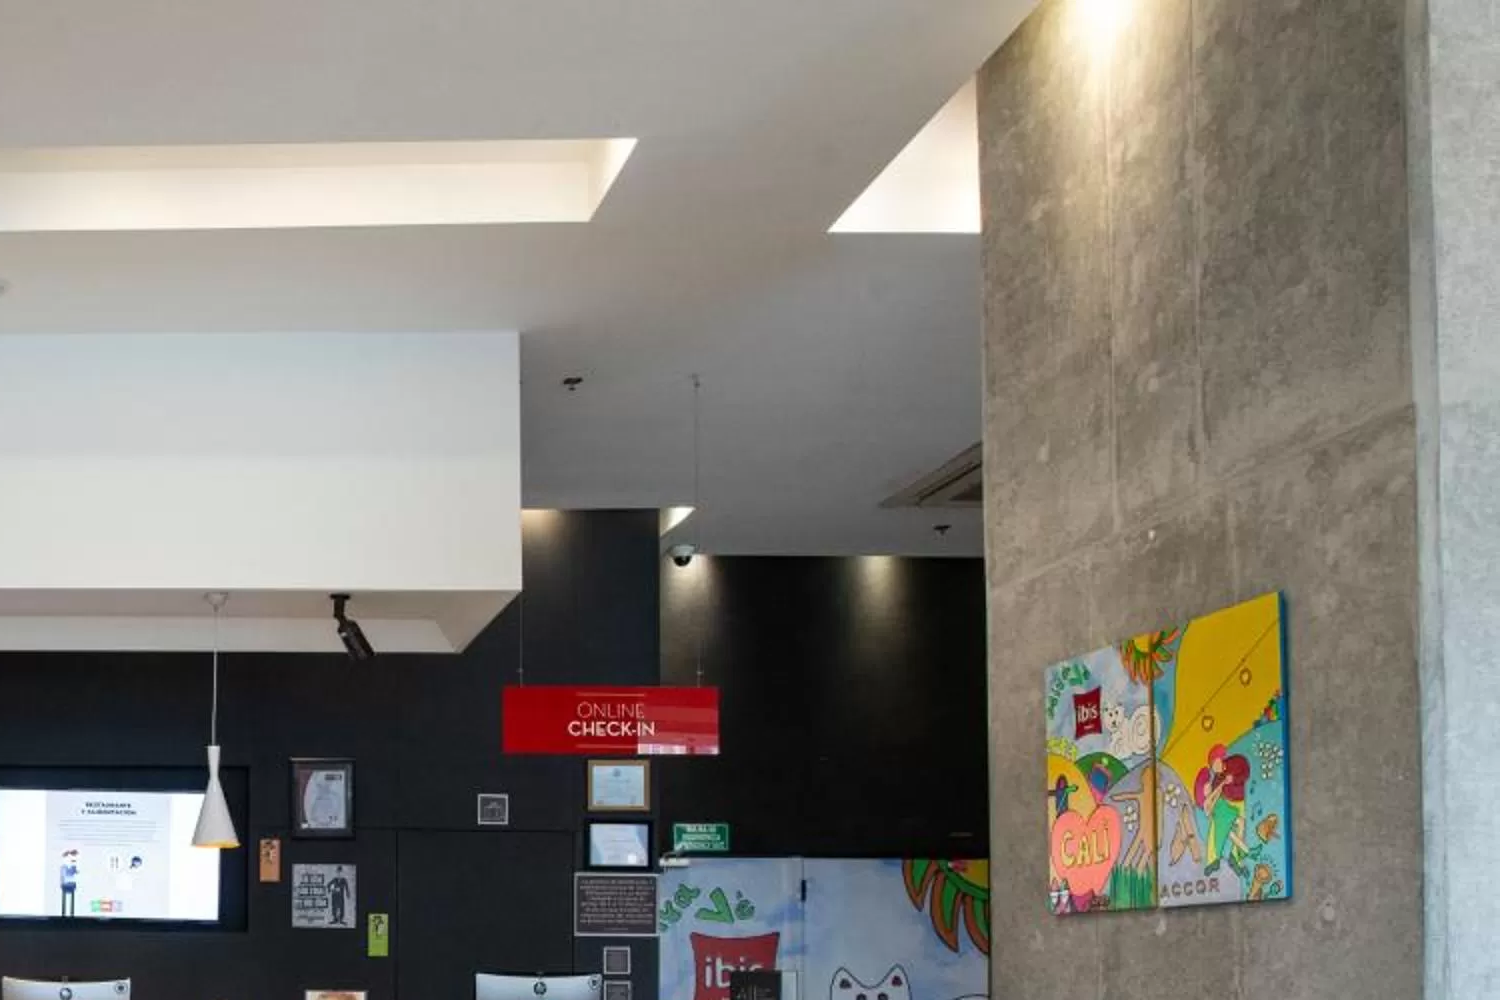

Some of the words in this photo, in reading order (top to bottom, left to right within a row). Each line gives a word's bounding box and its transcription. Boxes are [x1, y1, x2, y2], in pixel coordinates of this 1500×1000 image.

[577, 701, 645, 719] ONLINE
[567, 720, 656, 737] CHECK-IN
[1160, 877, 1221, 898] ACCOR
